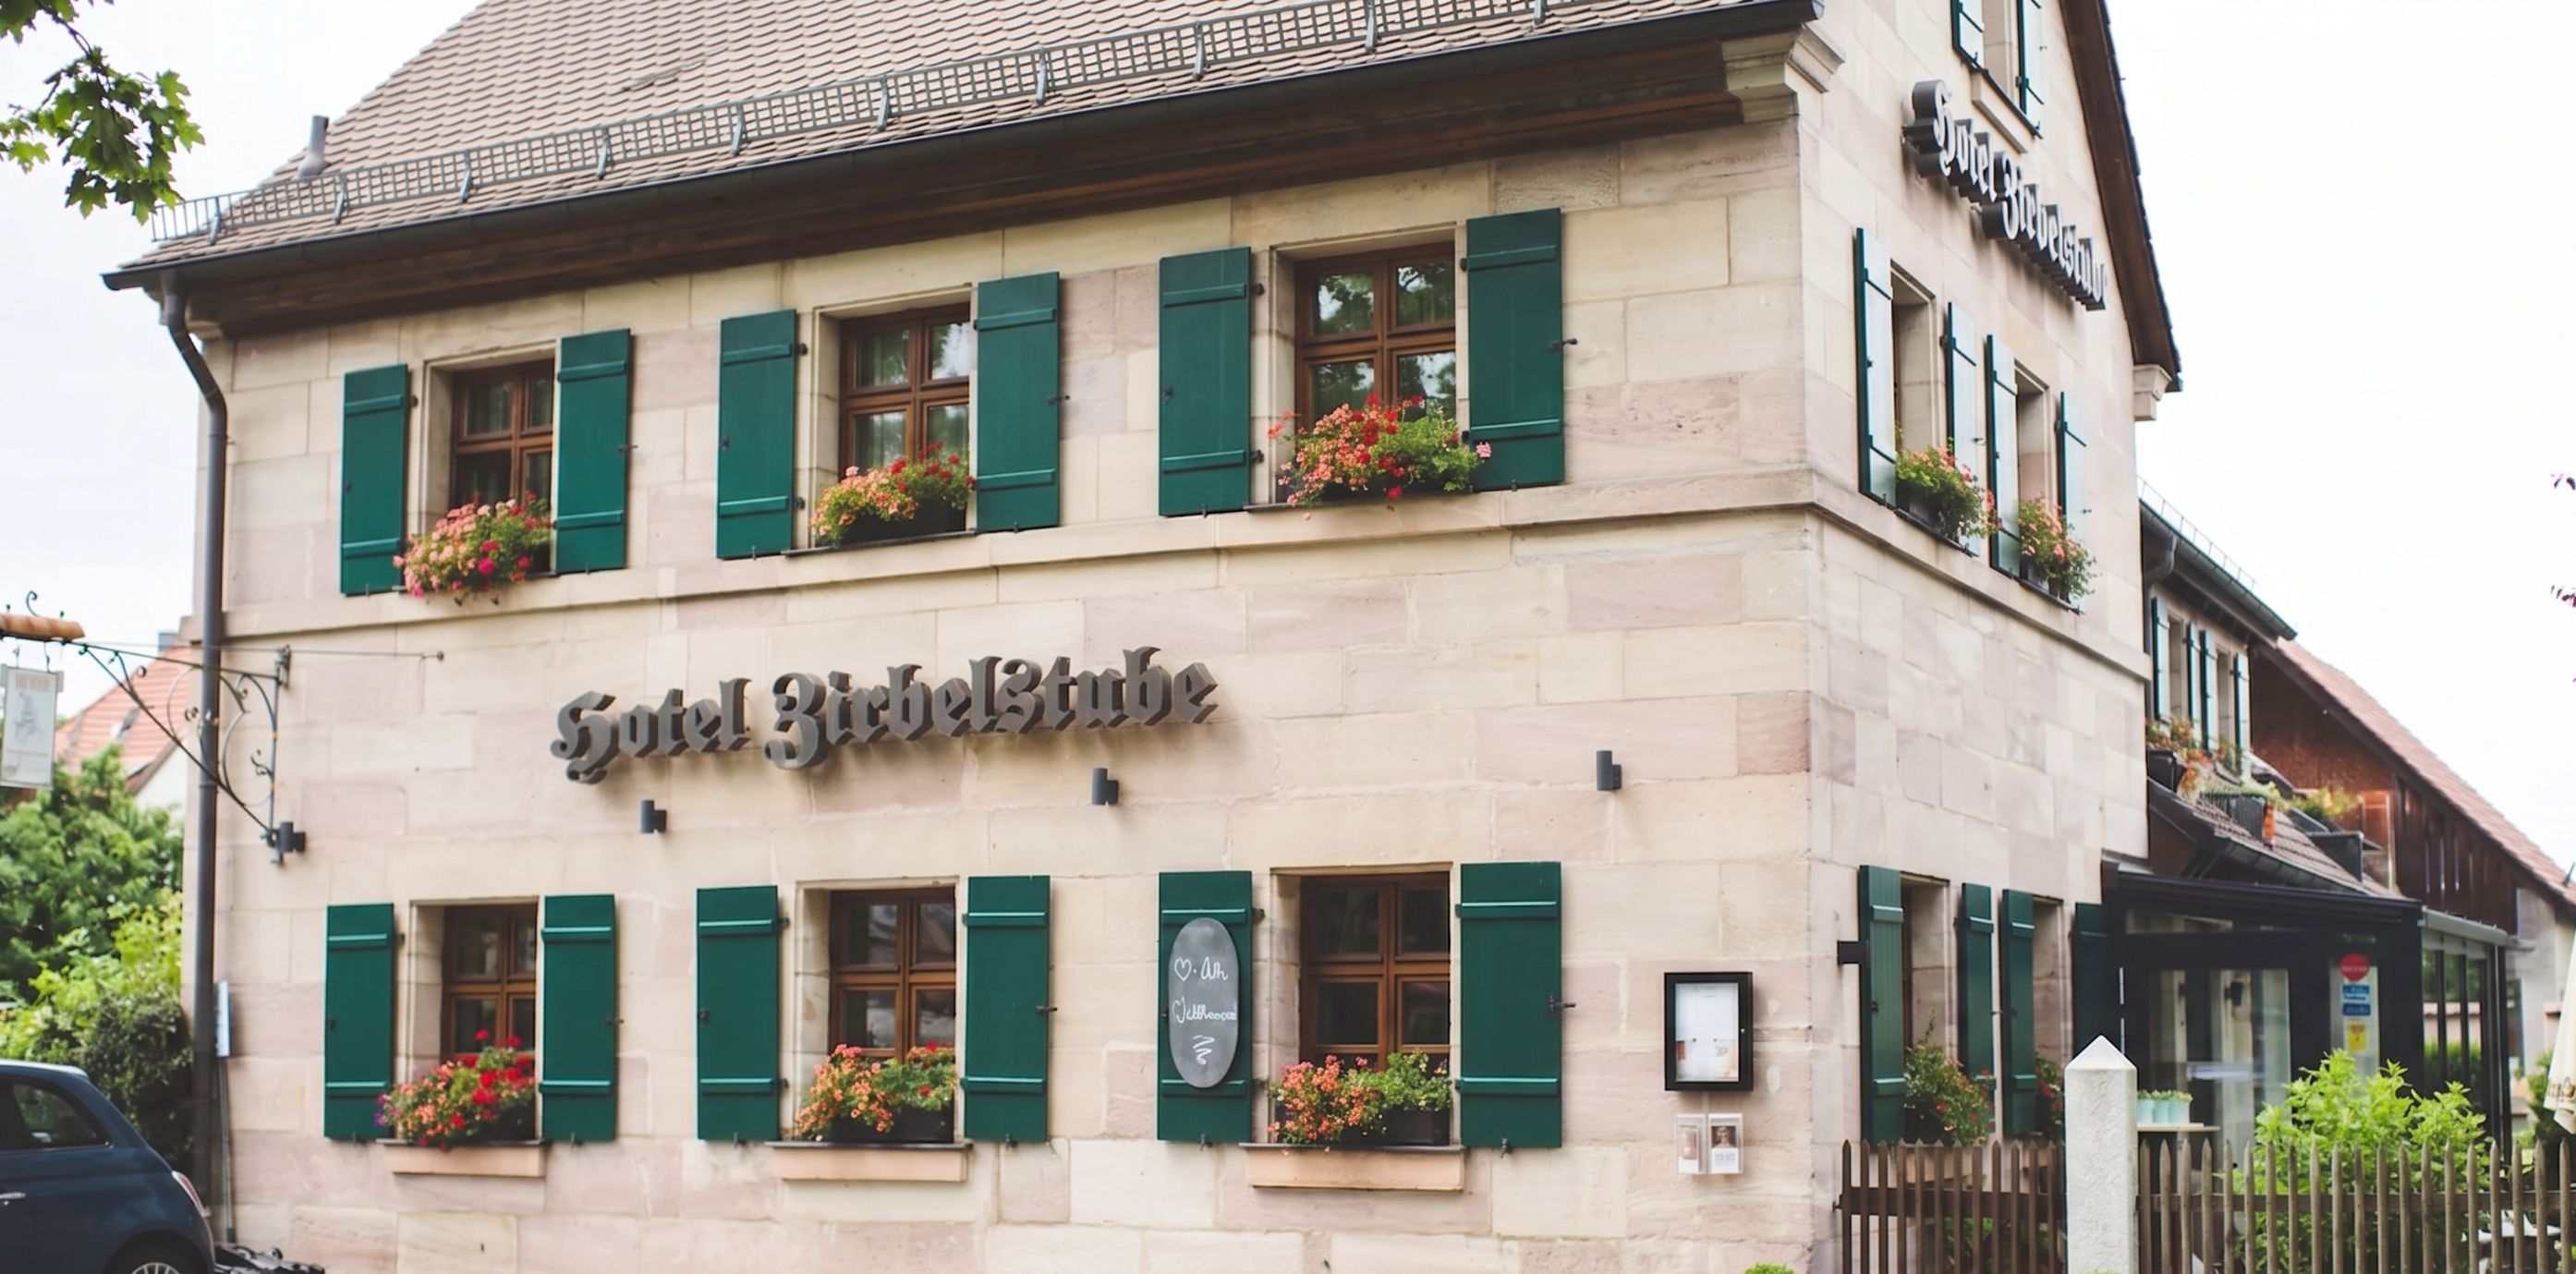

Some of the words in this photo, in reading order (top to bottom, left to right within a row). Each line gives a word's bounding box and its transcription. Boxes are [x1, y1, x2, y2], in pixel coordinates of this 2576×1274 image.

[1912, 79, 1998, 202] Hotel
[551, 677, 752, 783] Hotel
[764, 647, 1218, 769] Zirbelstube
